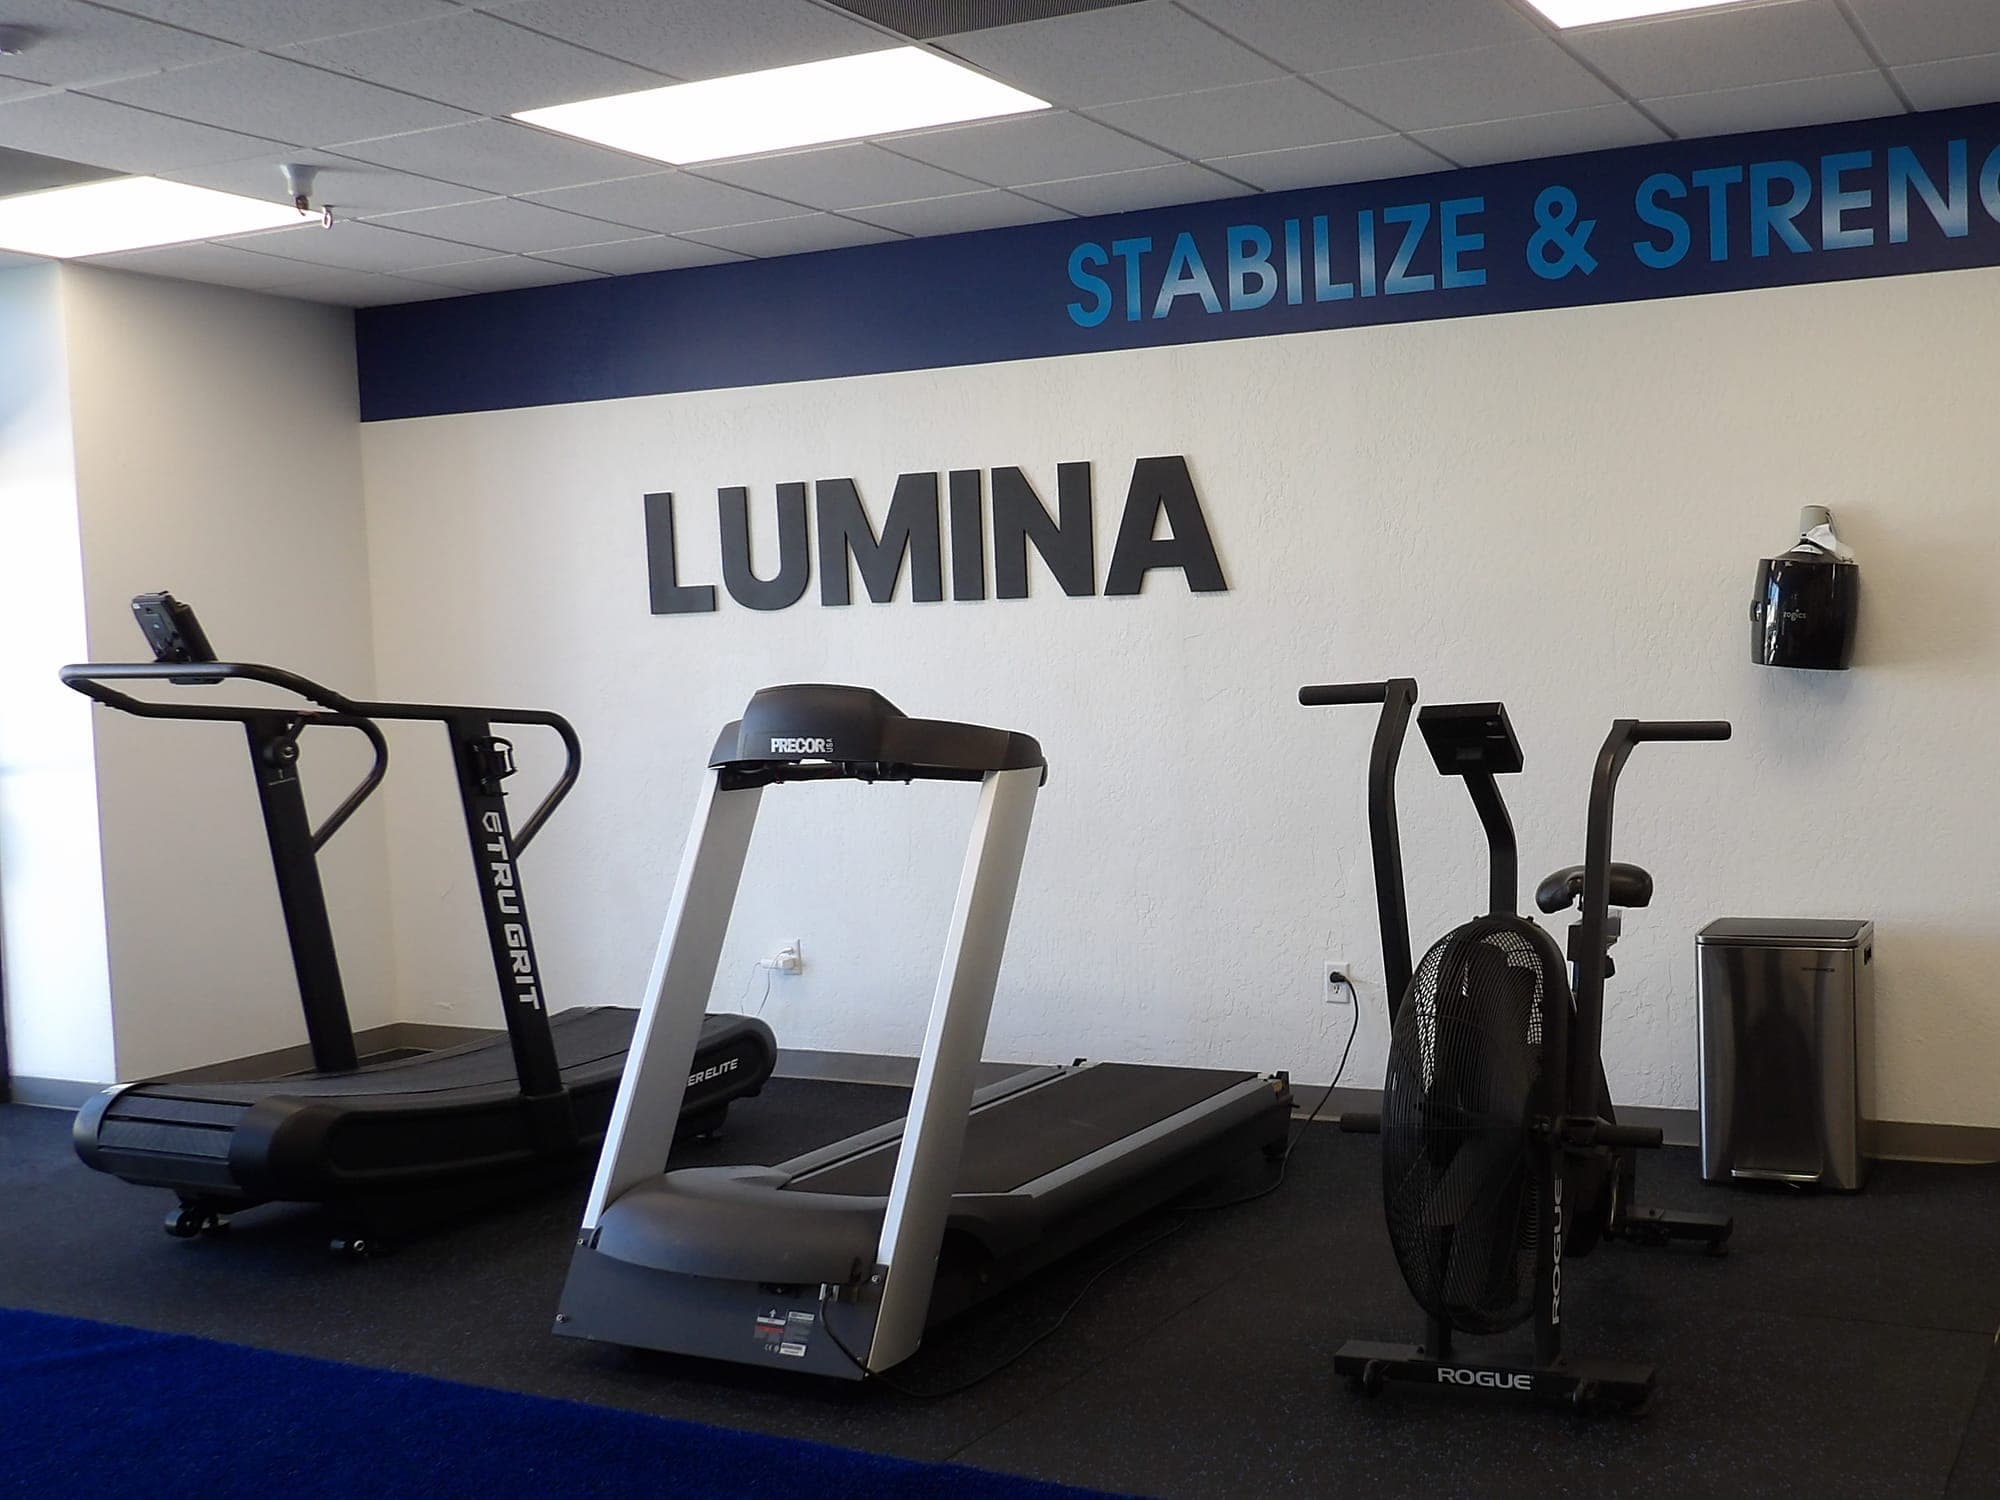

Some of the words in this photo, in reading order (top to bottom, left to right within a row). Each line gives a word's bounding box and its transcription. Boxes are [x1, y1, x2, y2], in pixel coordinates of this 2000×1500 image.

[1067, 196, 1487, 327] STABILIZE
[1526, 185, 1598, 279] &
[643, 455, 1229, 615] LUMINA
[770, 737, 826, 753] PRECOR
[826, 738, 834, 753] USA
[486, 836, 521, 914] TRU
[503, 923, 540, 1010] GRIT
[1552, 1173, 1562, 1325] ROGUE
[1437, 1366, 1531, 1390] ROGUE
